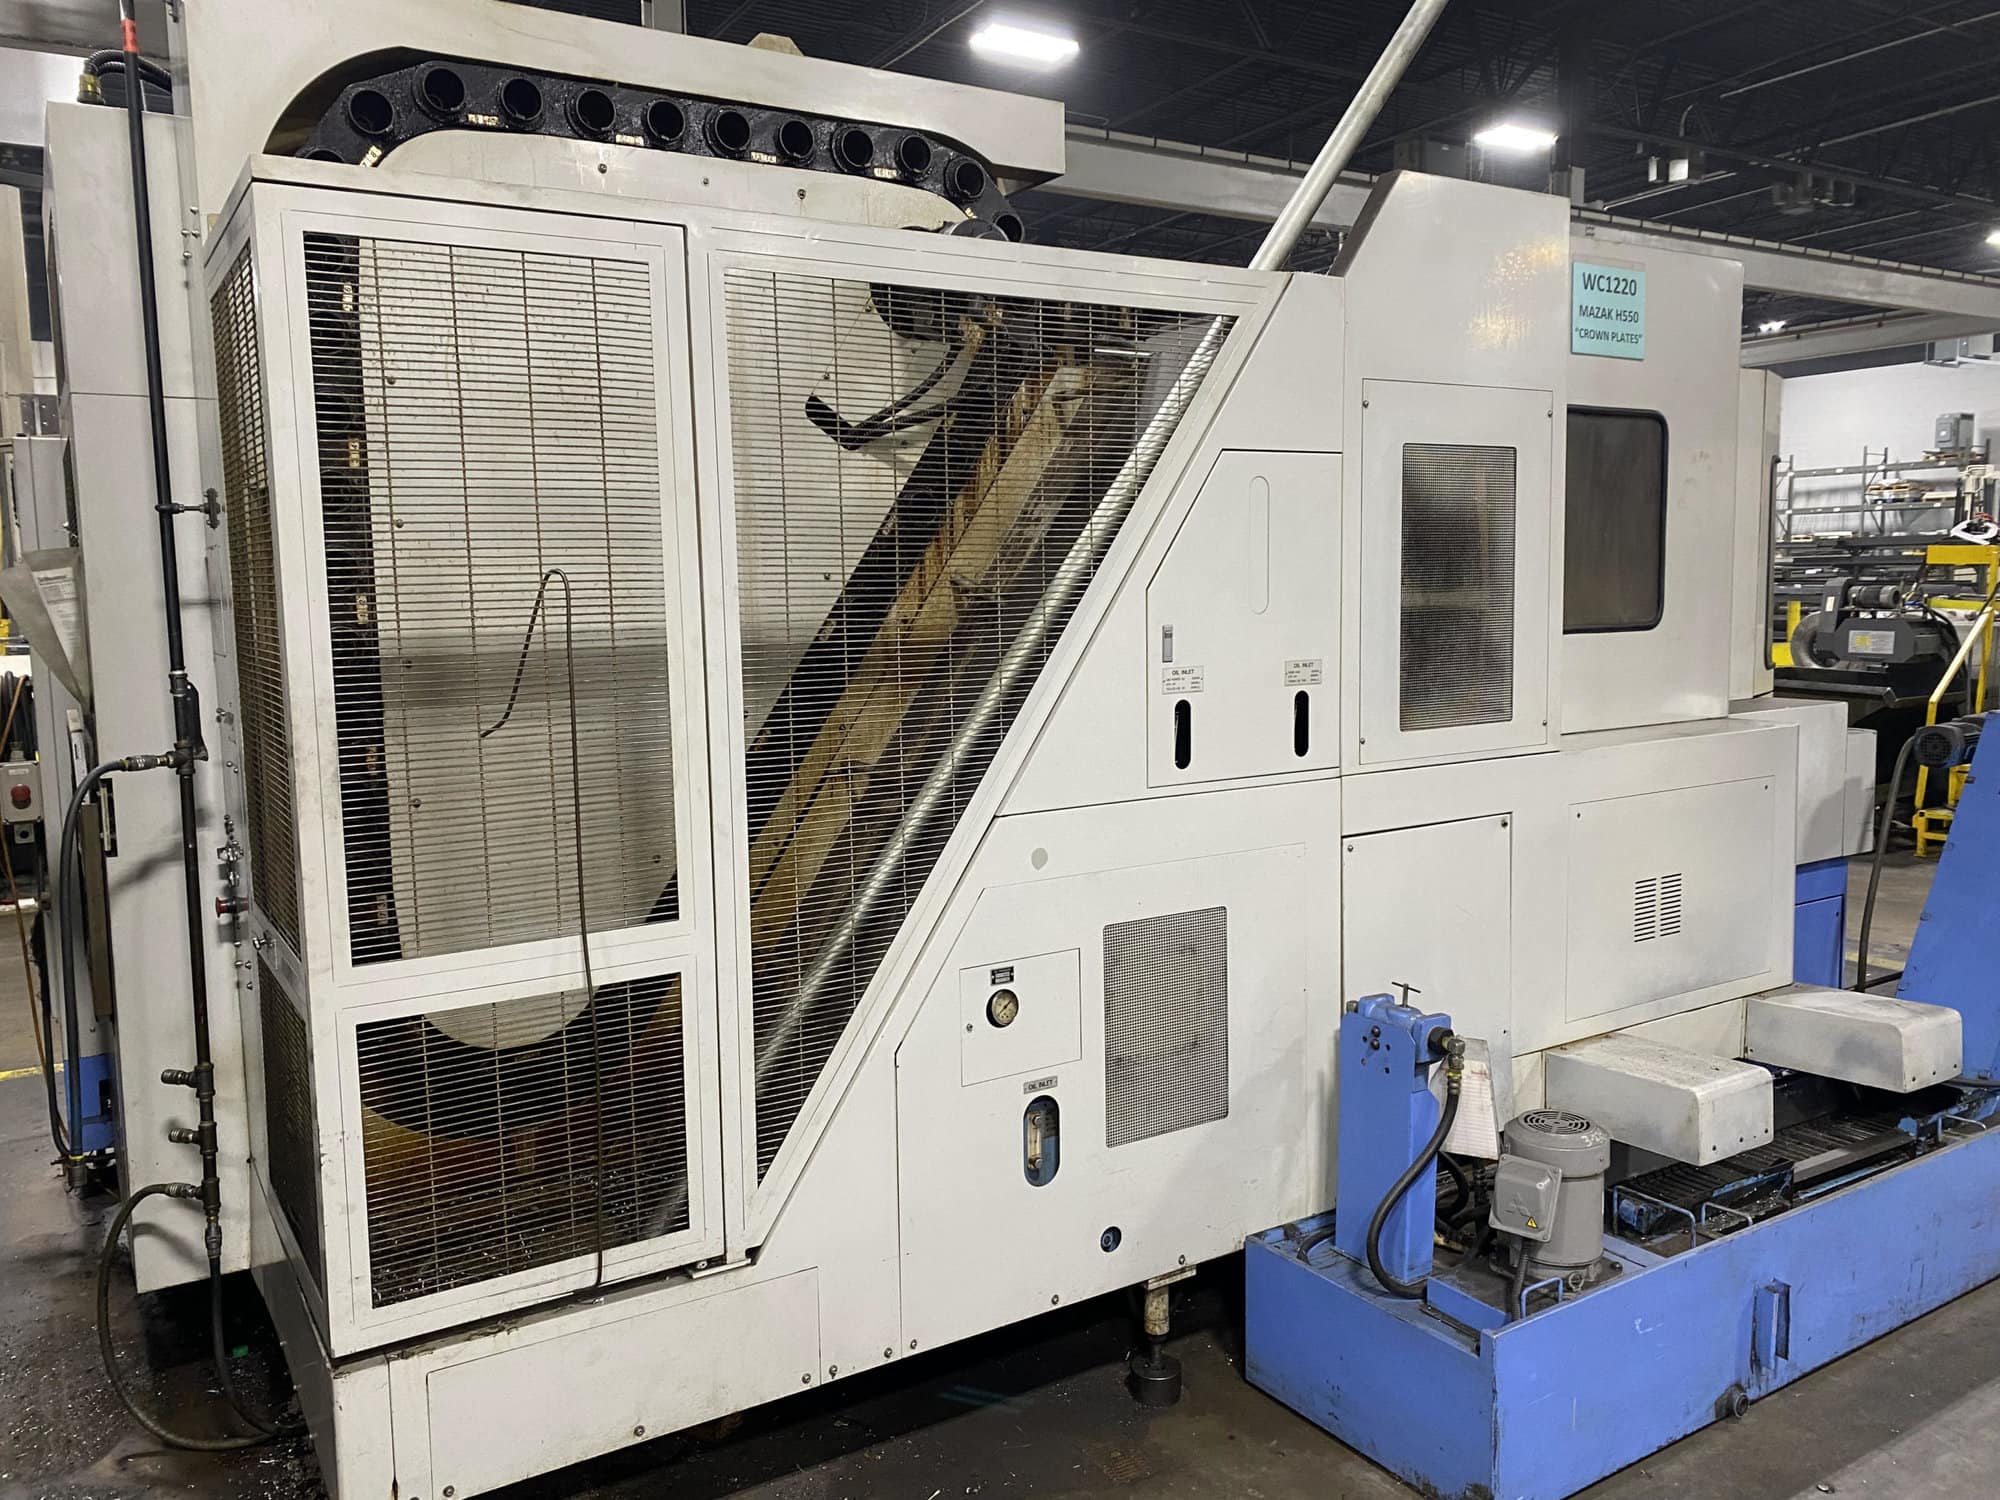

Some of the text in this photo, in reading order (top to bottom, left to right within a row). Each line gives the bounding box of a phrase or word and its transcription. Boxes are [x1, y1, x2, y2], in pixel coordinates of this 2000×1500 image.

[1582, 271, 1637, 296] WC1220
[1579, 304, 1639, 323] MAZAK H550
[1574, 327, 1643, 344] "CROWN PLATES"
